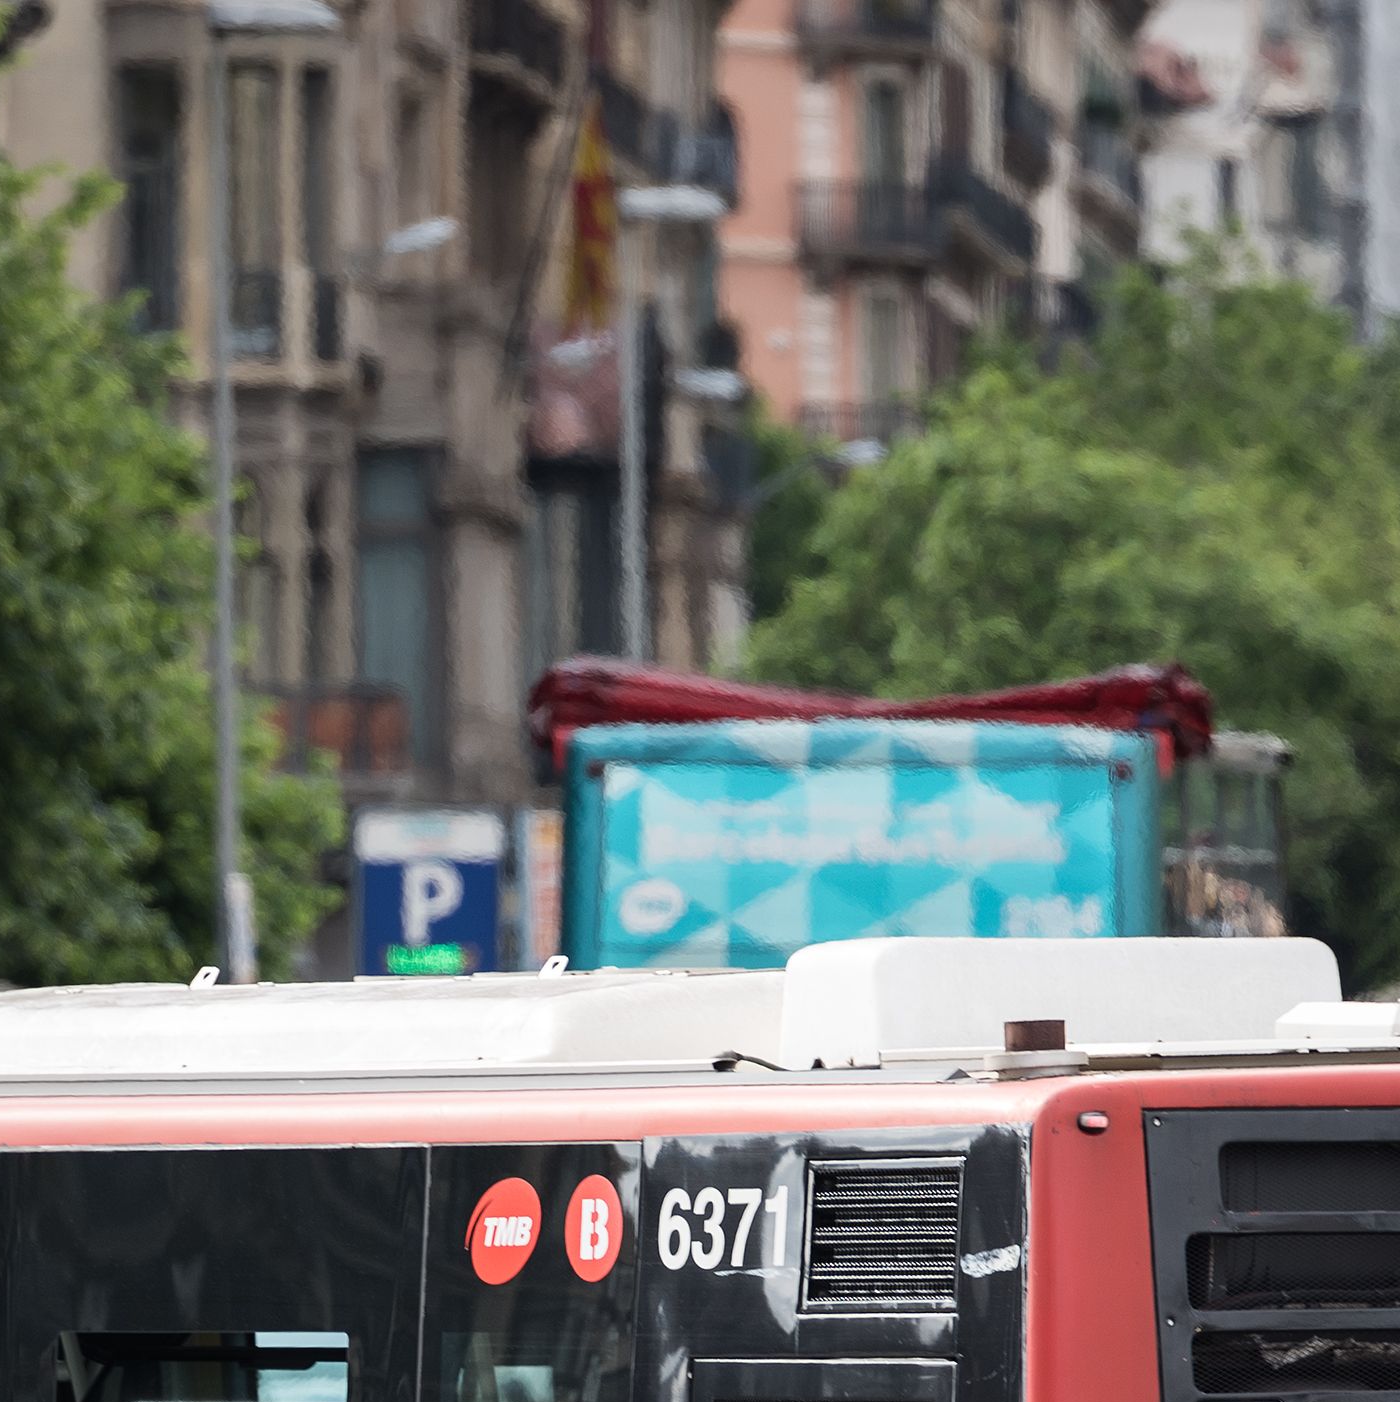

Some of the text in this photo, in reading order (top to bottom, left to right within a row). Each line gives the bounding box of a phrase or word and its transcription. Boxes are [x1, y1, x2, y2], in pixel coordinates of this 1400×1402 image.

[402, 860, 464, 944] P
[484, 1217, 532, 1246] TMB
[657, 1185, 788, 1270] 6371
